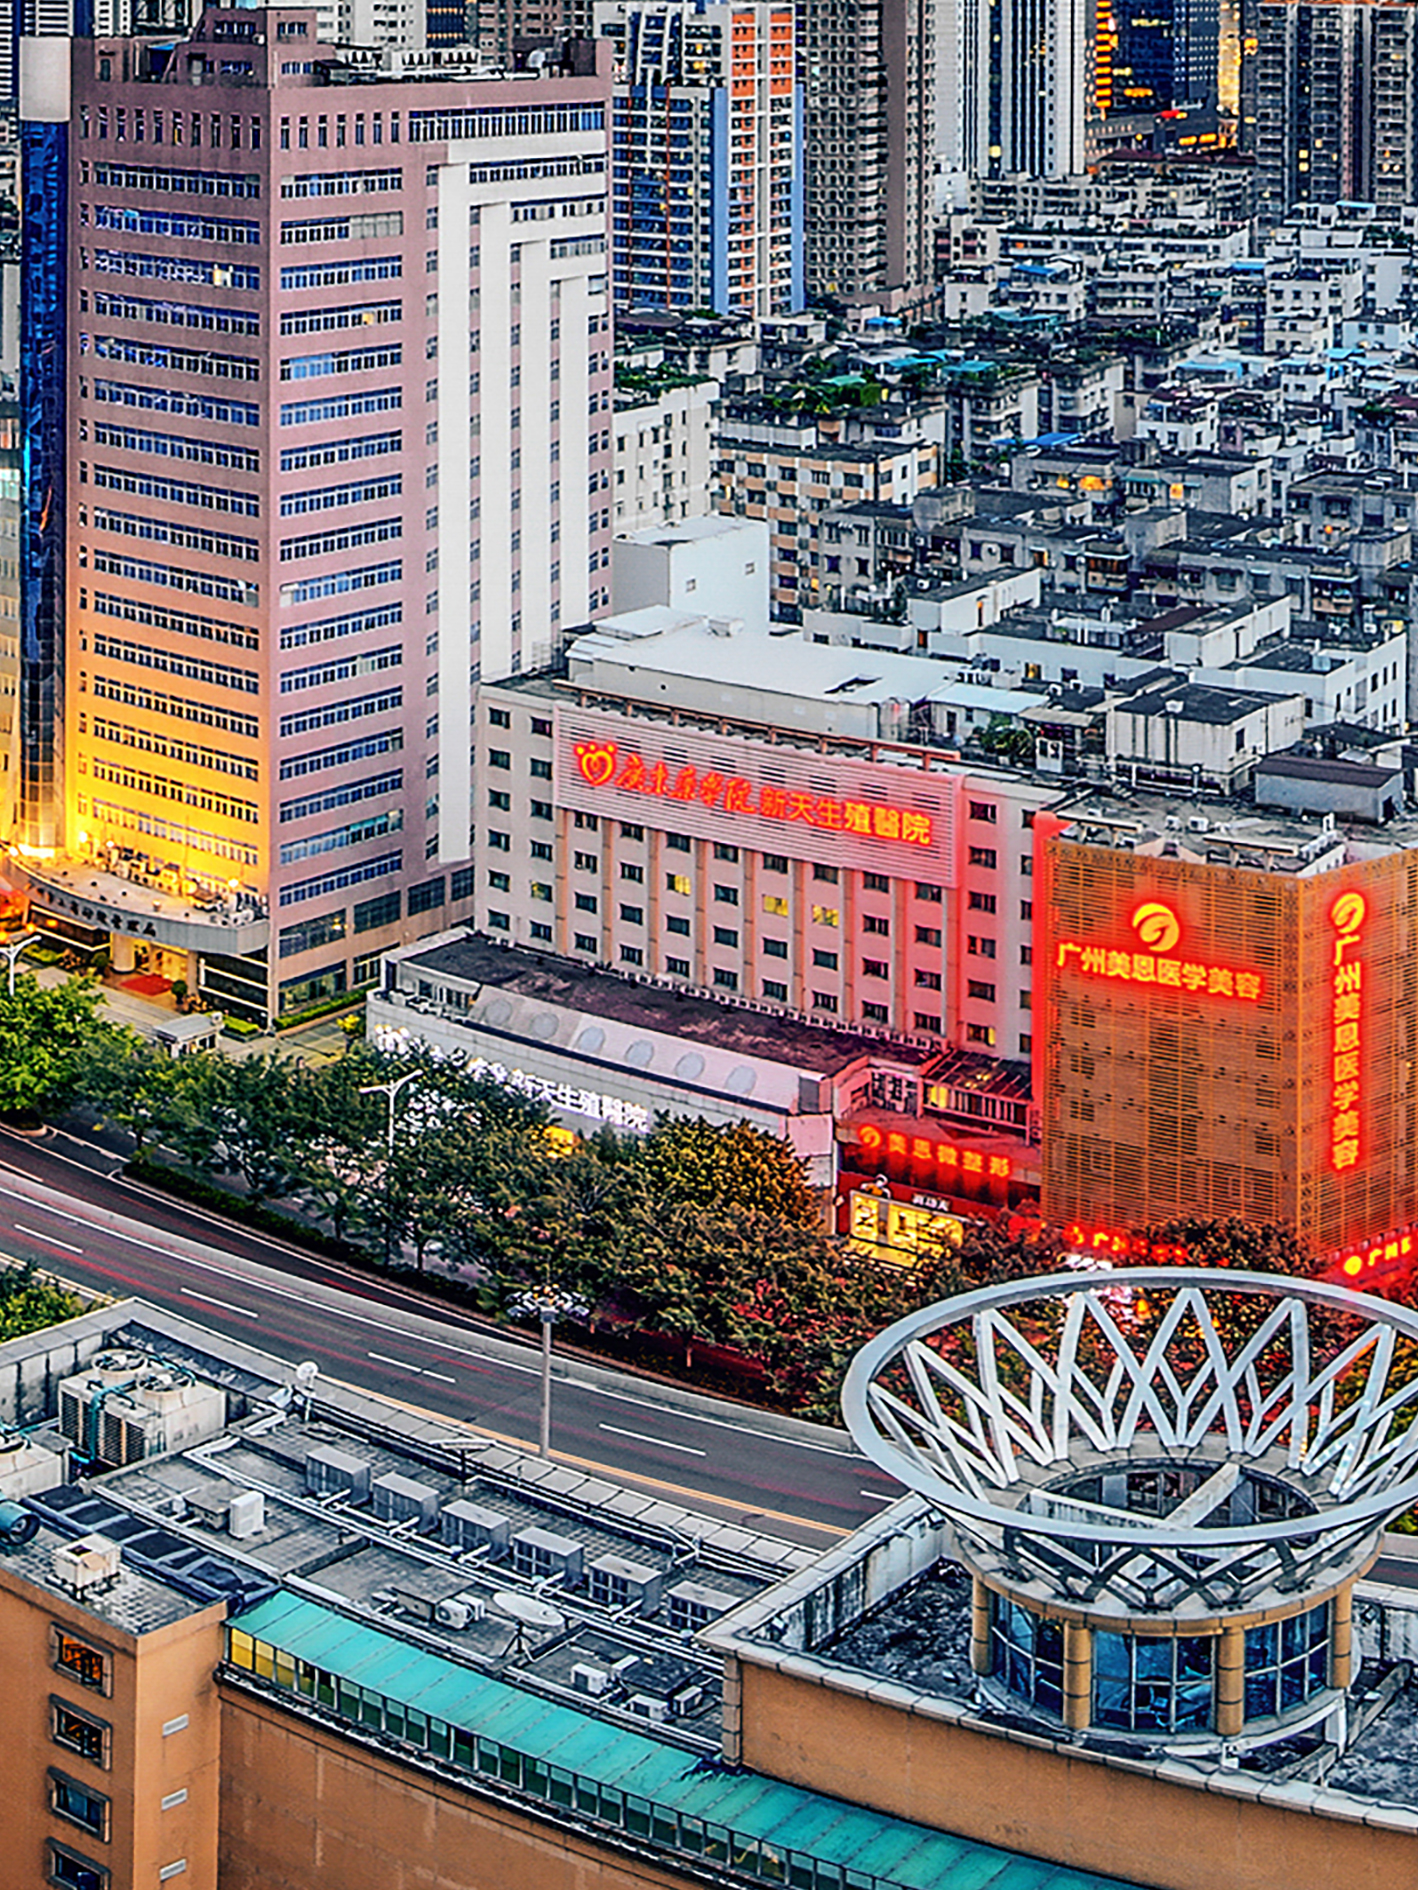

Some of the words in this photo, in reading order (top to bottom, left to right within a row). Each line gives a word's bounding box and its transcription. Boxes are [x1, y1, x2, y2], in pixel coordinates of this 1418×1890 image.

[1057, 942, 1261, 999] 广州美恩医学美容
[1332, 935, 1361, 1170] 广州美恩医学美容
